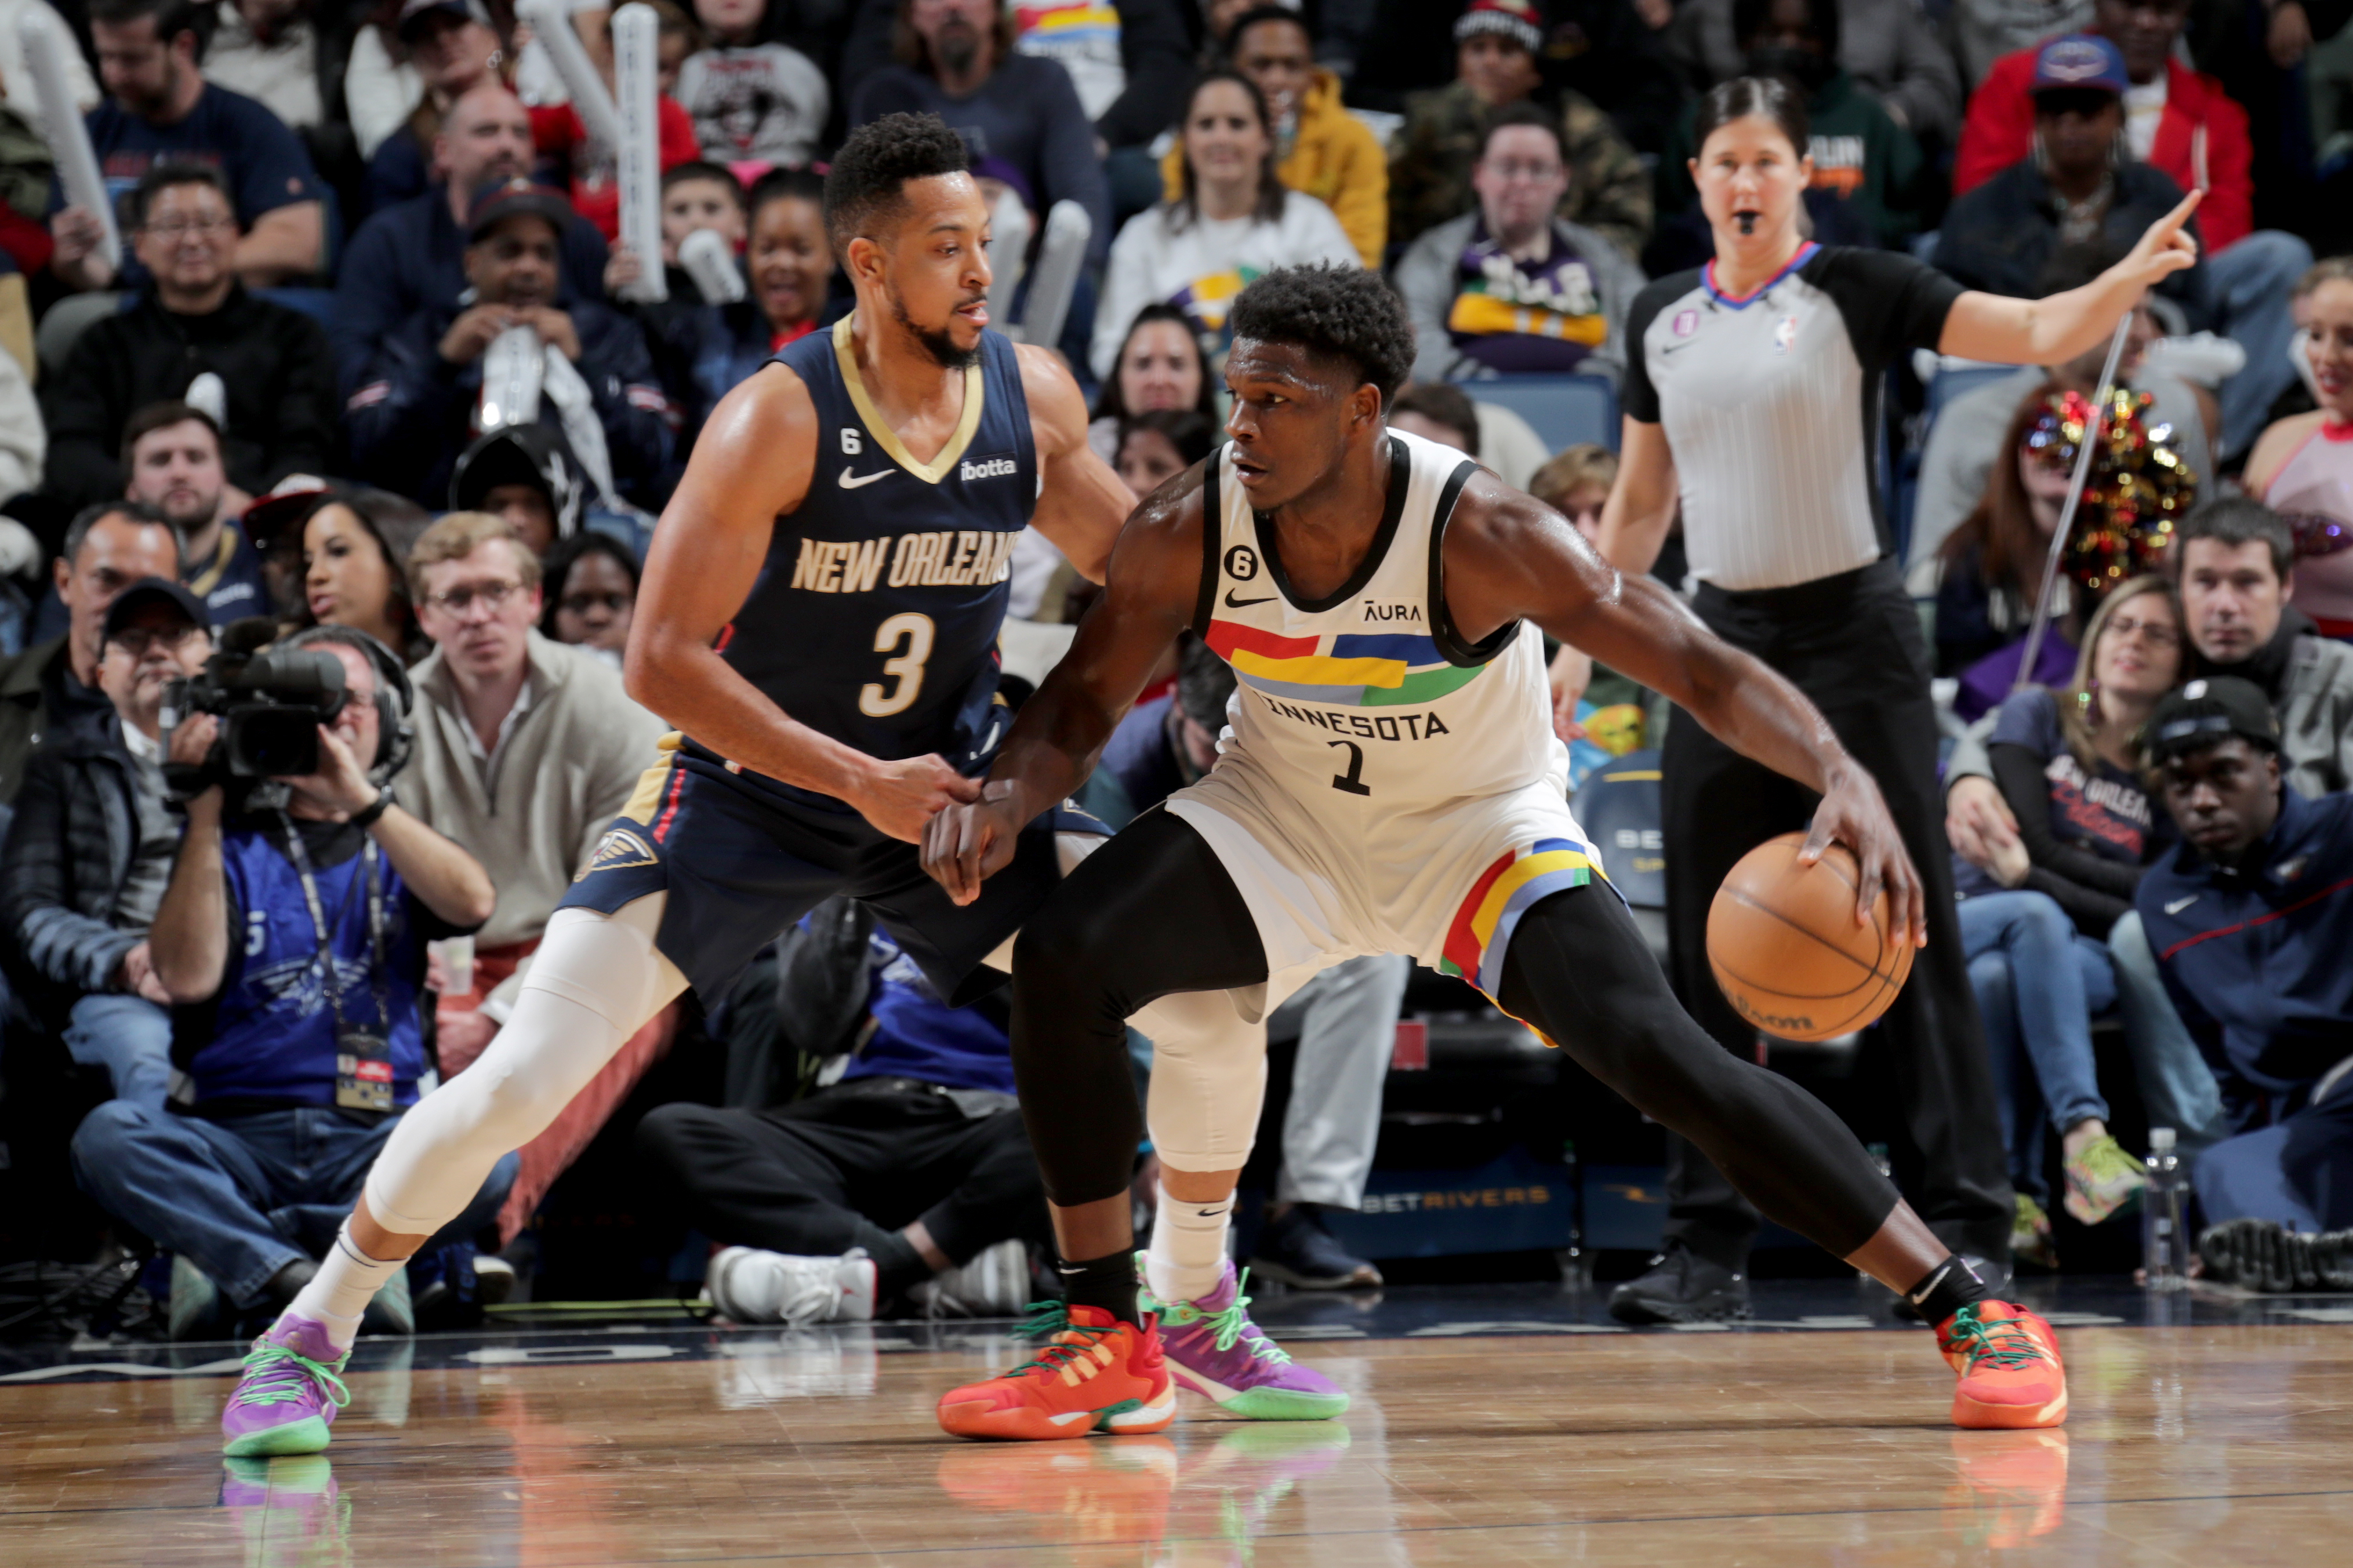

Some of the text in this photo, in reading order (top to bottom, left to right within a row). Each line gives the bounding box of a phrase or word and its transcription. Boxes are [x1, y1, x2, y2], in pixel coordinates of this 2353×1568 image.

[841, 428, 862, 454] 6
[961, 458, 1016, 481] ibotta
[790, 537, 892, 593] NEW
[1233, 550, 1252, 577] 6
[859, 612, 935, 718] 3
[1326, 740, 1371, 797] 1
[1615, 830, 1664, 849] BE
[1363, 1186, 1549, 1214] BETRIVERS
